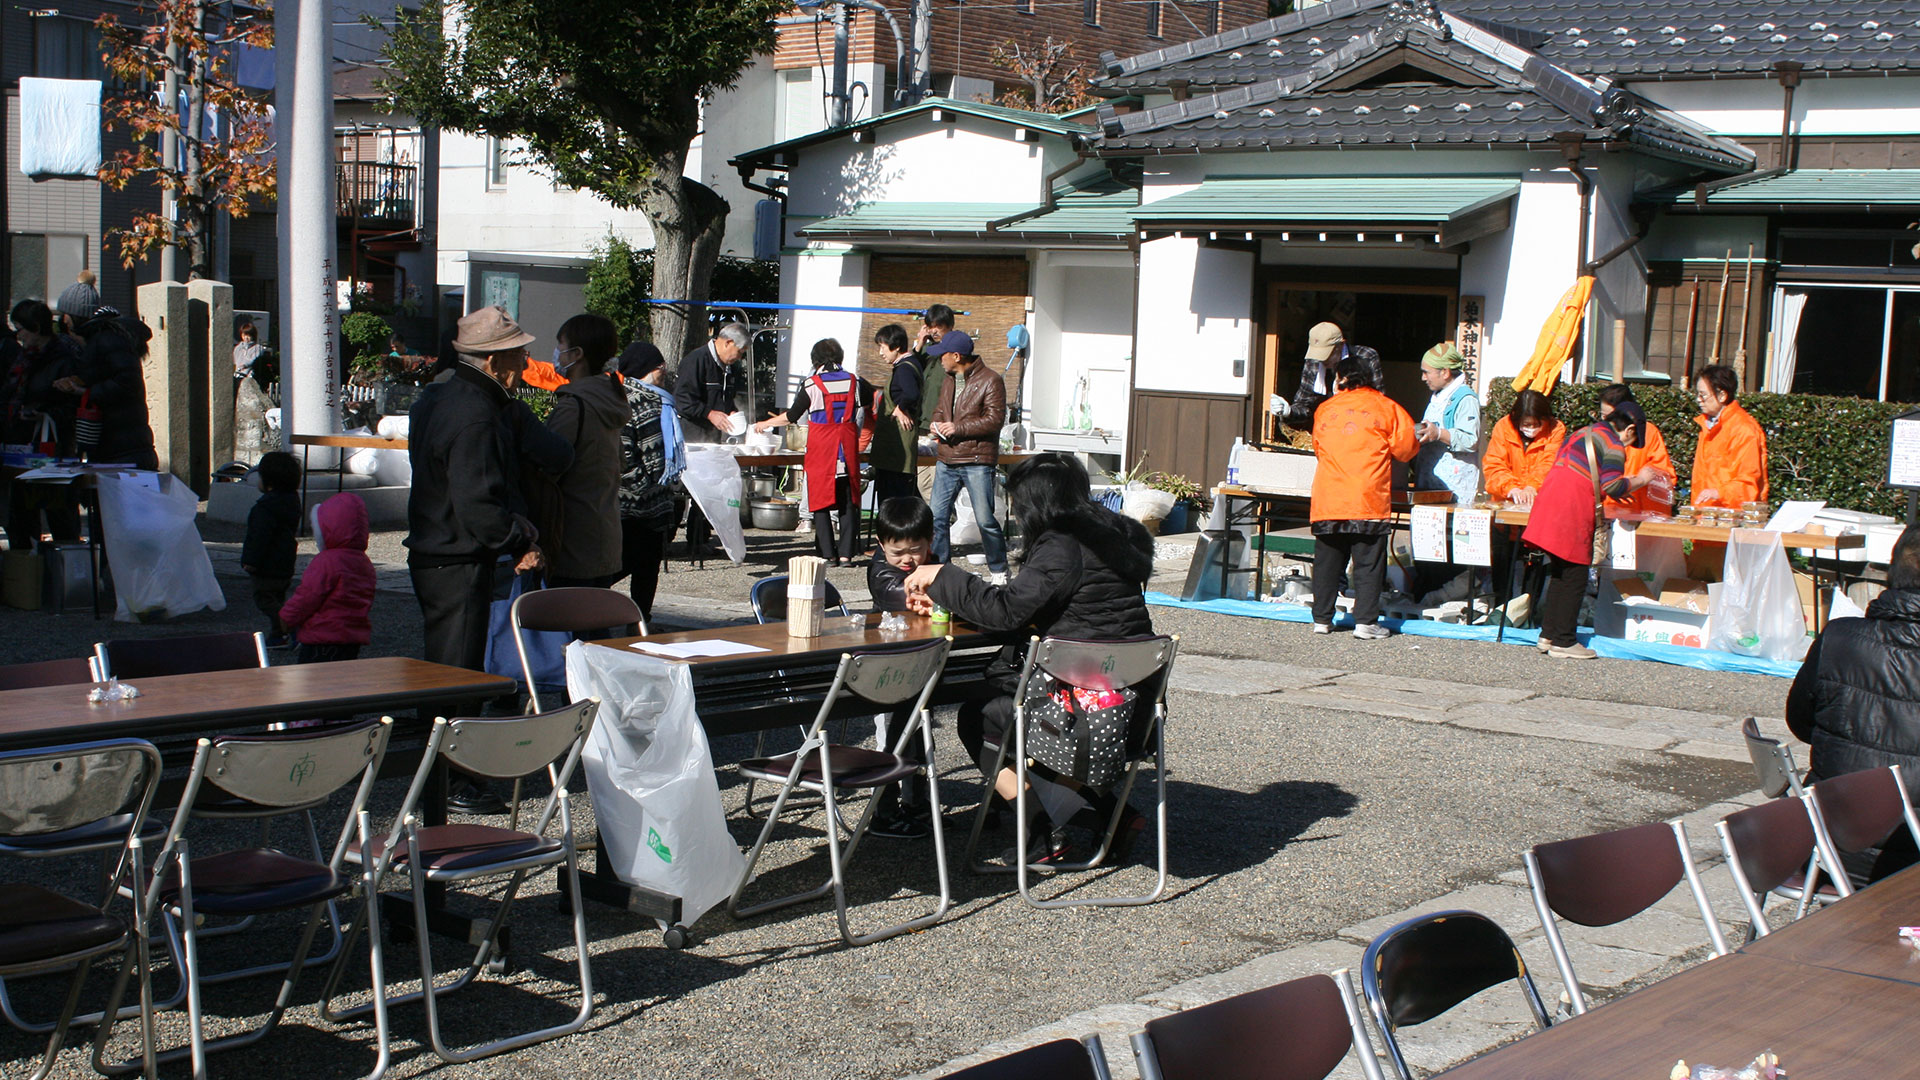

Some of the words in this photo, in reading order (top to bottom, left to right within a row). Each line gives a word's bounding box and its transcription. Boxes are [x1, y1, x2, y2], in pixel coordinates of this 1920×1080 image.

[321, 258, 335, 408] 平成十六年十月吉日建之
[1461, 301, 1479, 391] 柏木神社社務
[289, 752, 317, 786] 南
